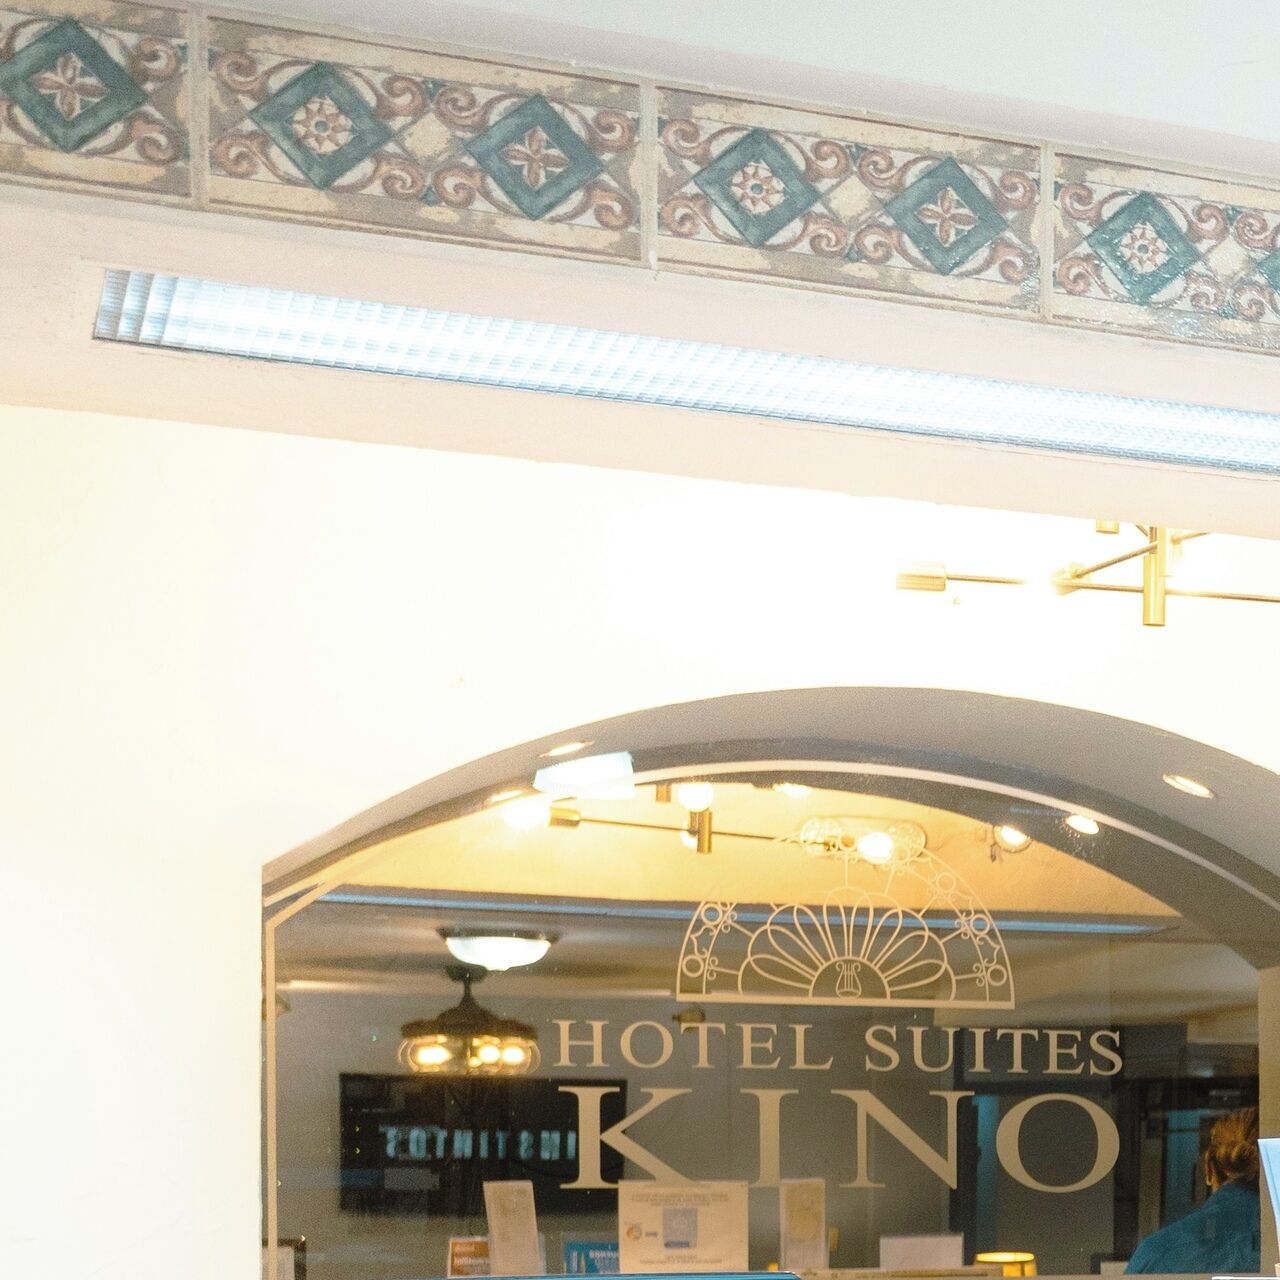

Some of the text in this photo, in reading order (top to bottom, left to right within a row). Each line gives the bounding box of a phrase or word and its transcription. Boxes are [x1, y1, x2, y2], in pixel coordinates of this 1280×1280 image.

[551, 1019, 1124, 1077] HOTEL SUITES
[557, 1086, 1121, 1192] KINO
